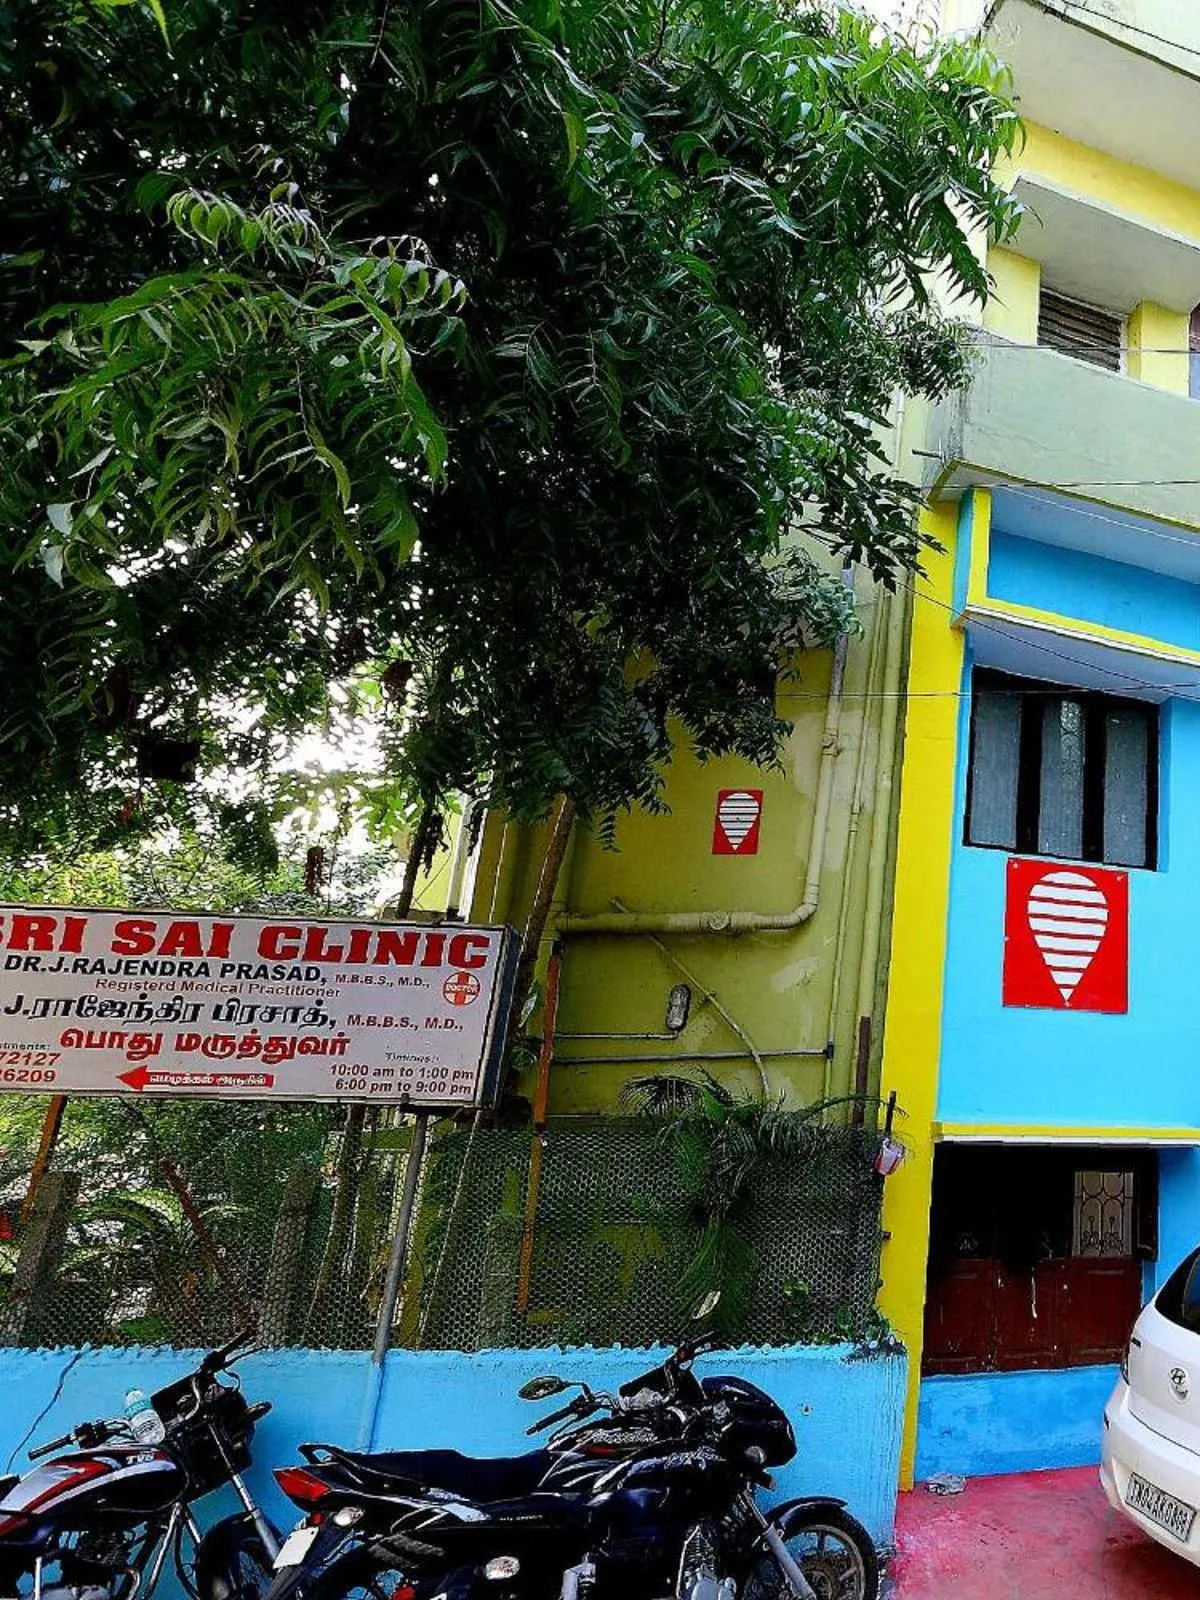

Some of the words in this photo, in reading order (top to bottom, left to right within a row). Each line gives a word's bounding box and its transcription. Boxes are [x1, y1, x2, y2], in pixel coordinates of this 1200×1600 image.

[0, 914, 89, 954] RI
[111, 919, 235, 959] SAI
[257, 926, 490, 969] CLINIC
[5, 954, 211, 977] DR.J.RAJENDRA
[219, 962, 327, 986] PRASAD,
[95, 978, 176, 993] Registerd
[180, 980, 243, 994] Medical
[249, 983, 340, 998] Practitioner
[60, 1028, 164, 1062] பொது
[175, 1028, 351, 1065] மருத்துவர்
[0, 1068, 57, 1083] 6209
[331, 1064, 369, 1077] 10:00
[372, 1068, 395, 1078] am
[399, 1067, 414, 1078] to
[418, 1067, 449, 1079] 1:00
[452, 1070, 474, 1081] pm
[335, 1079, 367, 1091] 6:00
[369, 1081, 393, 1093] pm
[398, 1081, 412, 1092] to
[415, 1081, 446, 1093] 9:00
[450, 1083, 472, 1095] pm
